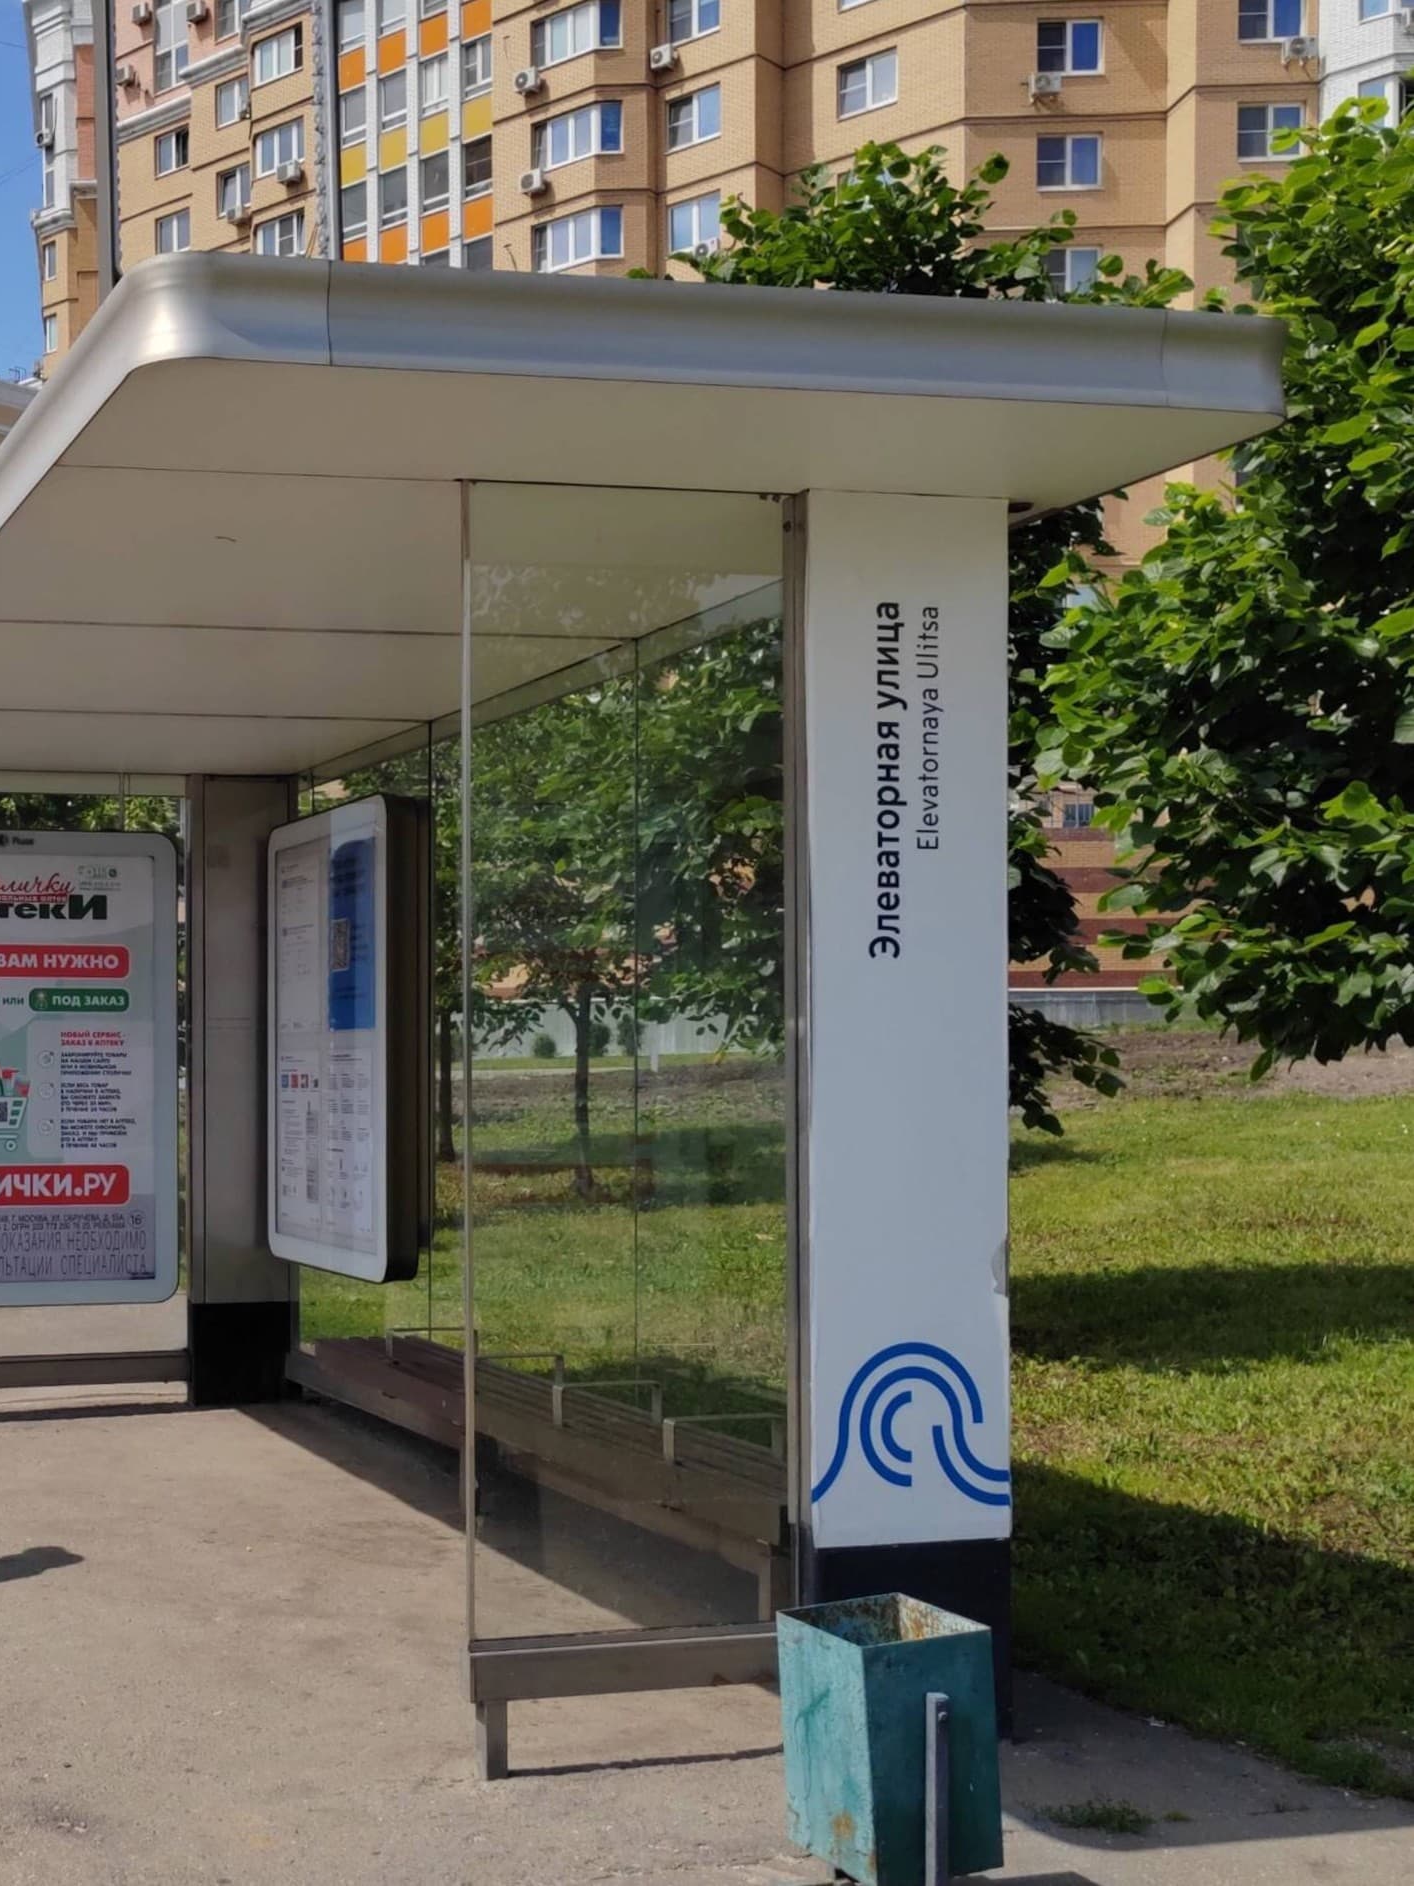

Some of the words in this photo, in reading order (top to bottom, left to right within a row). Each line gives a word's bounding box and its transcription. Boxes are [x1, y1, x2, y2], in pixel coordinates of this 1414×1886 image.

[876, 601, 907, 711] улица
[916, 605, 940, 679] Ulitsa
[916, 687, 944, 850] Elevatornaya
[869, 720, 907, 959] Элеваторная
[43, 953, 119, 971] НУЖНО
[52, 995, 80, 1009] ПОД
[84, 996, 125, 1007] ЗАКАЗ
[61, 1254, 148, 1276] СПЕЦИАЛИСТА
[67, 1229, 147, 1253] НЕОБХОДИМО
